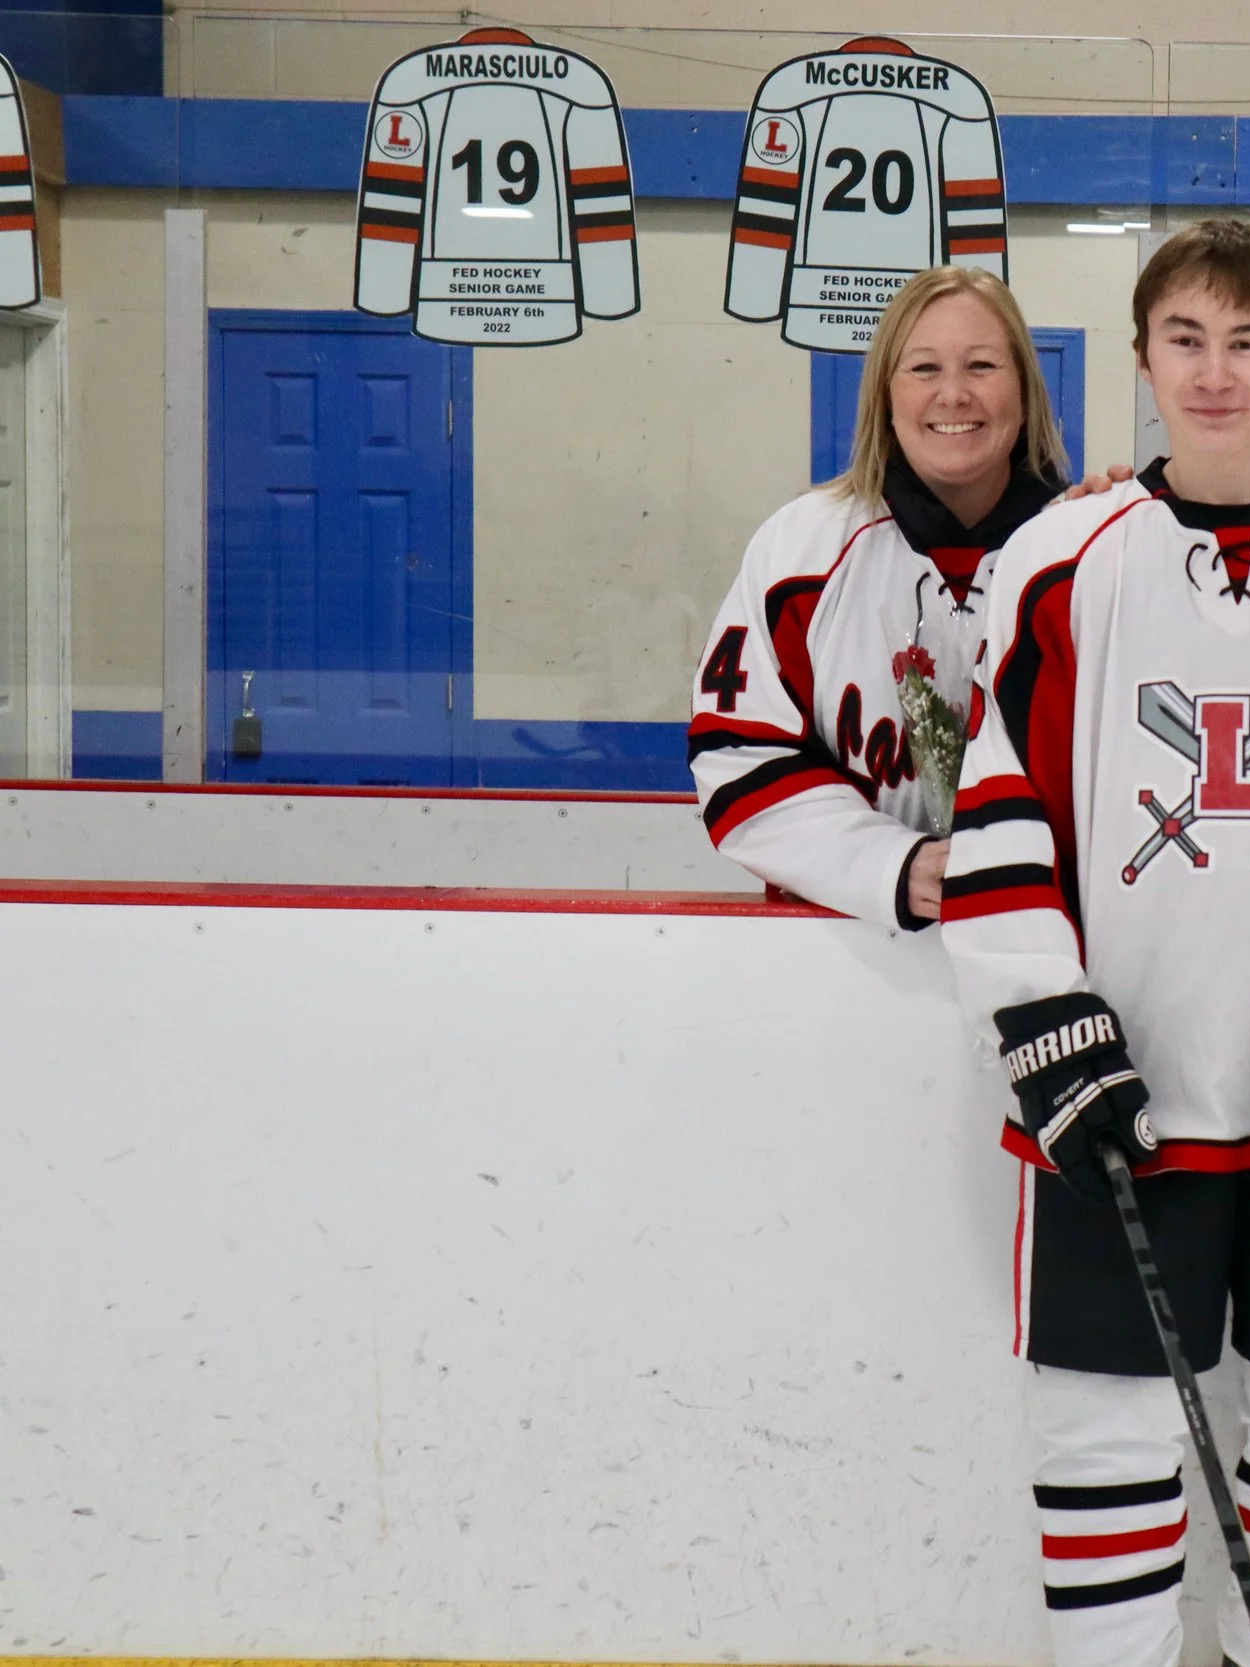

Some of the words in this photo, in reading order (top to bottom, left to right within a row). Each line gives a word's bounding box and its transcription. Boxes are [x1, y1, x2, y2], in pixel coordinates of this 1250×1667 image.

[426, 54, 569, 79] MARASCIULO
[805, 61, 951, 91] McCUSKER
[388, 115, 411, 146] L
[765, 121, 787, 151] L
[384, 145, 412, 153] HOCKEY
[760, 150, 789, 159] HOCKEY
[451, 139, 540, 206] 19
[822, 147, 915, 215] 20
[452, 267, 479, 278] FED
[483, 268, 541, 279] HOCKEY
[823, 275, 850, 285] FED
[449, 283, 501, 294] SENIOR
[505, 283, 545, 294] GAME
[819, 291, 871, 302] SENIOR
[875, 293, 894, 303] GA
[450, 306, 519, 317] FEBRUARY
[523, 307, 545, 317] 6th
[819, 313, 881, 325] FEBRUAR
[483, 323, 511, 333] 2022
[851, 331, 873, 341] 202
[701, 626, 748, 712] 4
[1003, 1013, 1117, 1083] ARRIOR
[1053, 1077, 1085, 1106] COVERT
